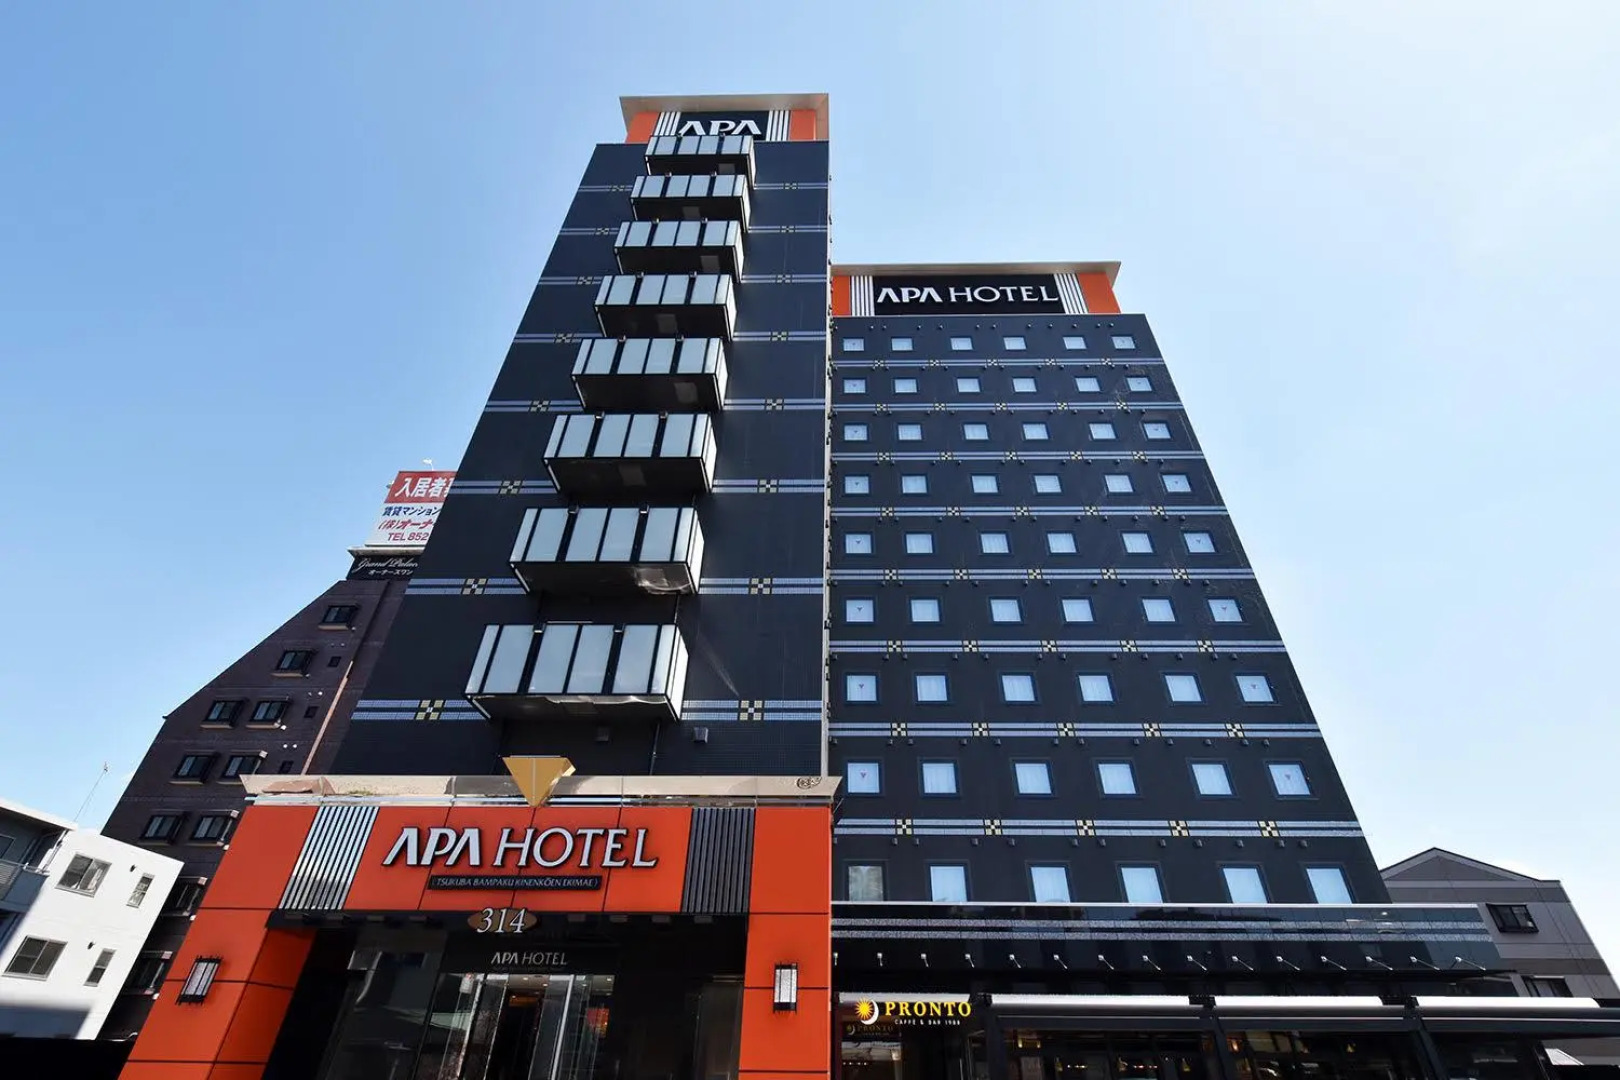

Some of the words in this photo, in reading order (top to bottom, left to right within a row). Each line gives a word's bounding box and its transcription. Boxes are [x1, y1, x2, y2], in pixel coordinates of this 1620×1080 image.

[678, 120, 762, 135] APA
[877, 287, 943, 303] APA
[950, 286, 1058, 302] HOTEL
[382, 827, 480, 866] APA
[492, 827, 657, 867] HOTEL
[476, 908, 527, 933] 314
[491, 952, 519, 964] APA
[521, 952, 567, 965] HOTEL
[884, 1001, 972, 1017] PRONTO
